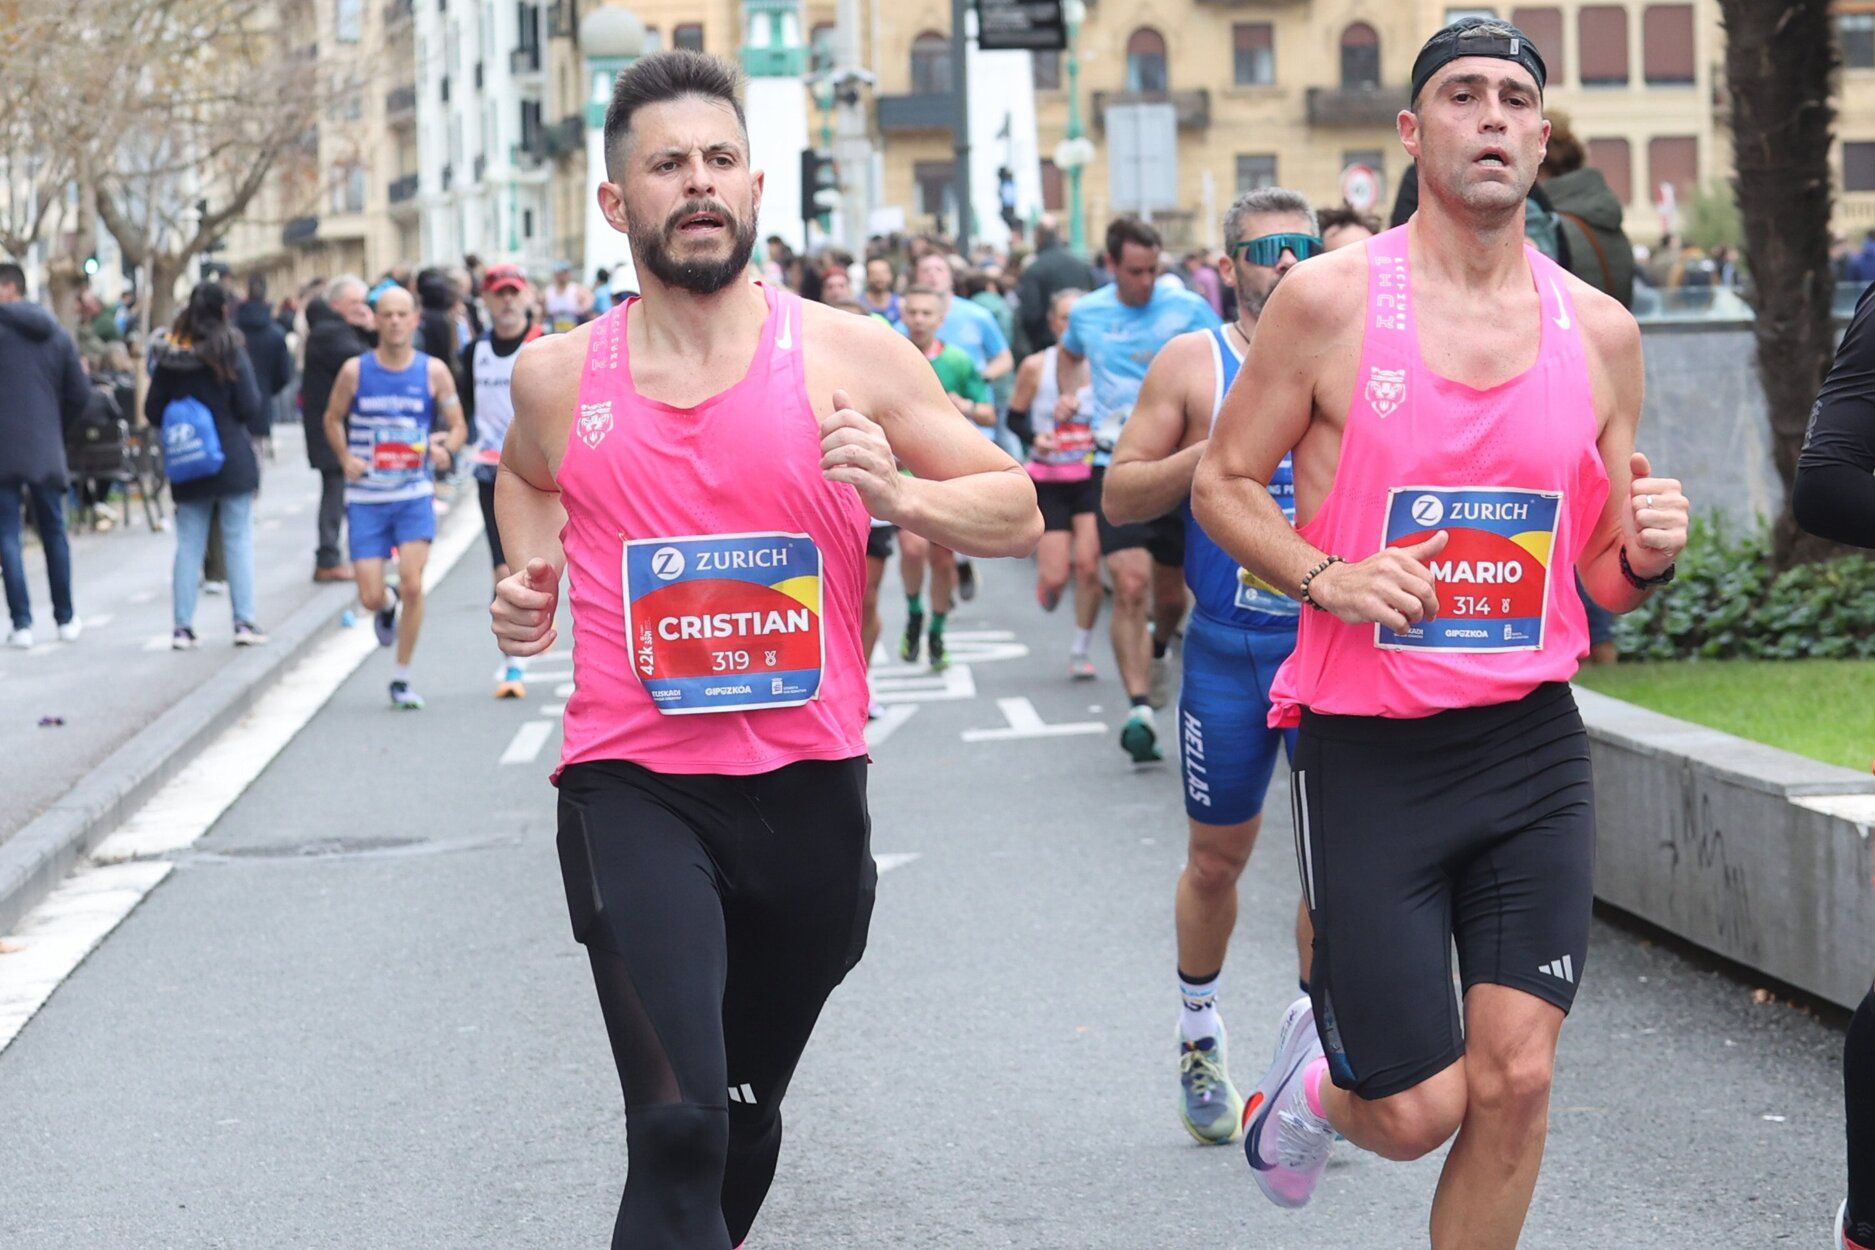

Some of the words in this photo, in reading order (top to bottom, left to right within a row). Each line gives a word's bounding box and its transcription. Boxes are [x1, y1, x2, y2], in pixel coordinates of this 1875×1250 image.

[1449, 502, 1528, 521] ZURICH
[696, 547, 788, 572] ZURICH
[1429, 560, 1523, 584] MARIO
[1452, 596, 1491, 615] 314
[657, 608, 809, 641] CRISTIAN
[1445, 629, 1488, 638] GIPUZKOA
[638, 646, 654, 676] 42k
[711, 650, 750, 671] 319
[704, 684, 752, 696] GIPUZKOA
[1183, 709, 1212, 807] HELLAS
